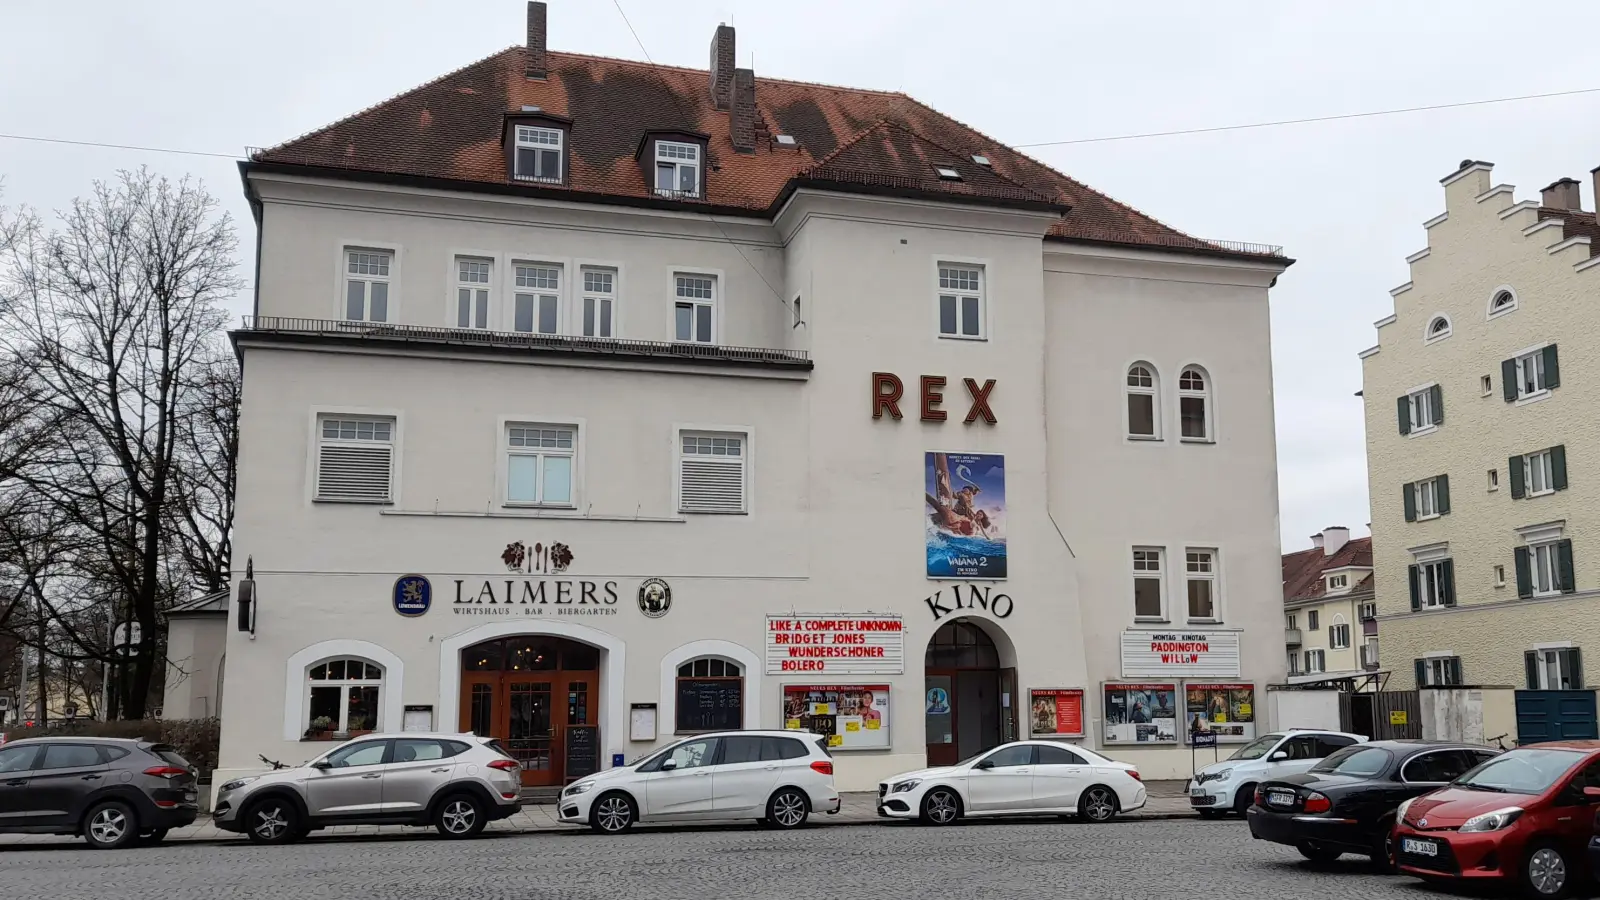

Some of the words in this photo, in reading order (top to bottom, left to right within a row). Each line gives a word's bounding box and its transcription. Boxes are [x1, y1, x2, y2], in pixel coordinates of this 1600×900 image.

[872, 371, 998, 424] REX
[946, 555, 979, 567] VAIANA
[979, 556, 989, 567] 2
[453, 579, 618, 605] LAIMERS
[923, 584, 1014, 621] KINO
[453, 607, 510, 615] WIRTSHAUS
[770, 620, 792, 631] LIKE
[794, 620, 802, 631] A
[805, 620, 854, 631] COMPLETE
[855, 620, 902, 632] UNKNOWN
[775, 633, 826, 644] BRIDGET
[831, 634, 865, 645] JONES
[1151, 642, 1209, 653] PADDINGTON
[781, 660, 824, 671] BOLERO
